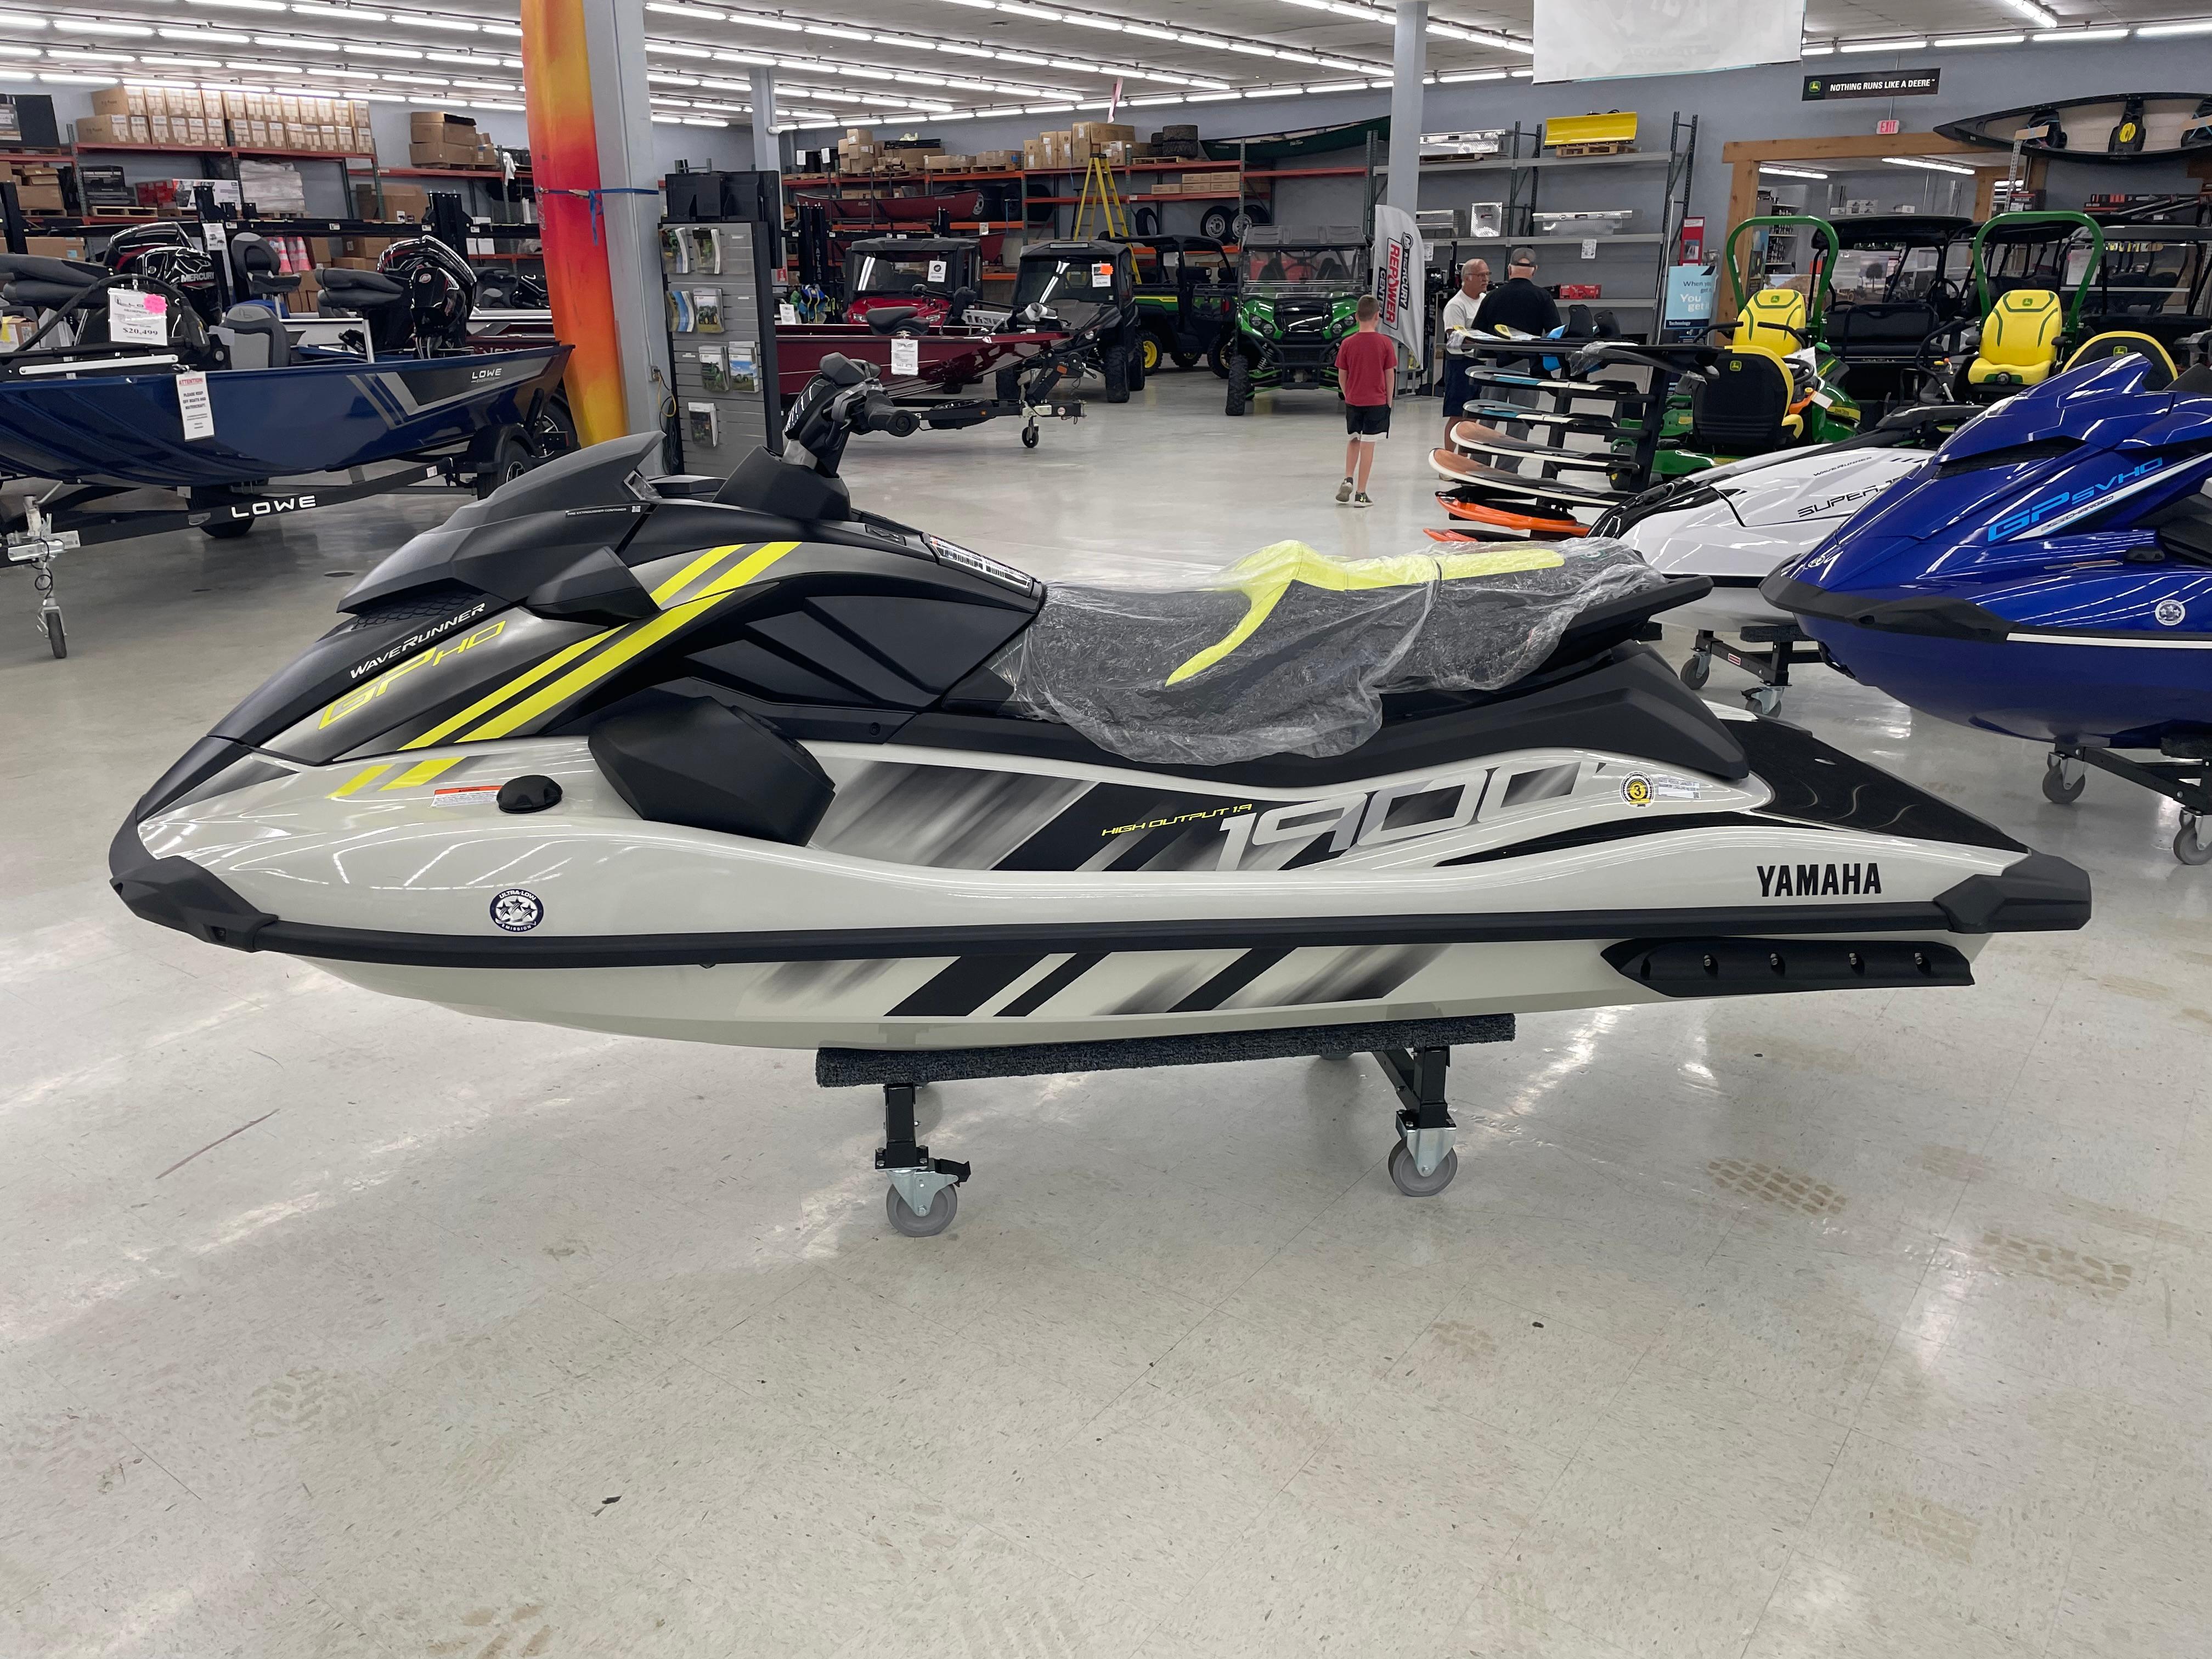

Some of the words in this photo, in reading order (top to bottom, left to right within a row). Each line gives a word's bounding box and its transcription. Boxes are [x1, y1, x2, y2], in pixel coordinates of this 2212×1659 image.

[1830, 82, 1862, 92] NOTHING
[1863, 81, 1883, 89] RUNS
[1884, 80, 1900, 89] LIKE
[1901, 80, 1906, 88] A
[1880, 120, 1897, 133] EXIT
[180, 272, 215, 283] MERCURY
[1386, 243, 1401, 324] REPOWER
[1400, 251, 1409, 308] MERCURY
[1680, 293, 1701, 302] You
[1688, 302, 1703, 312] get
[122, 327, 159, 336] $20,499
[472, 368, 502, 379] LOWE
[1988, 492, 2070, 542] GP
[2072, 456, 2163, 505] SVHO
[231, 495, 316, 518] LOWE
[317, 646, 437, 730] GP
[432, 620, 506, 667] HO
[1634, 785, 1641, 797] 3
[1101, 822, 1146, 836] HIGH
[1148, 808, 1229, 828] OUTPUT
[1232, 803, 1252, 813] 1.9
[1215, 760, 1598, 872] 1900
[1756, 862, 1882, 898] YAMAHA
[499, 890, 537, 901] ULTRA-LOW
